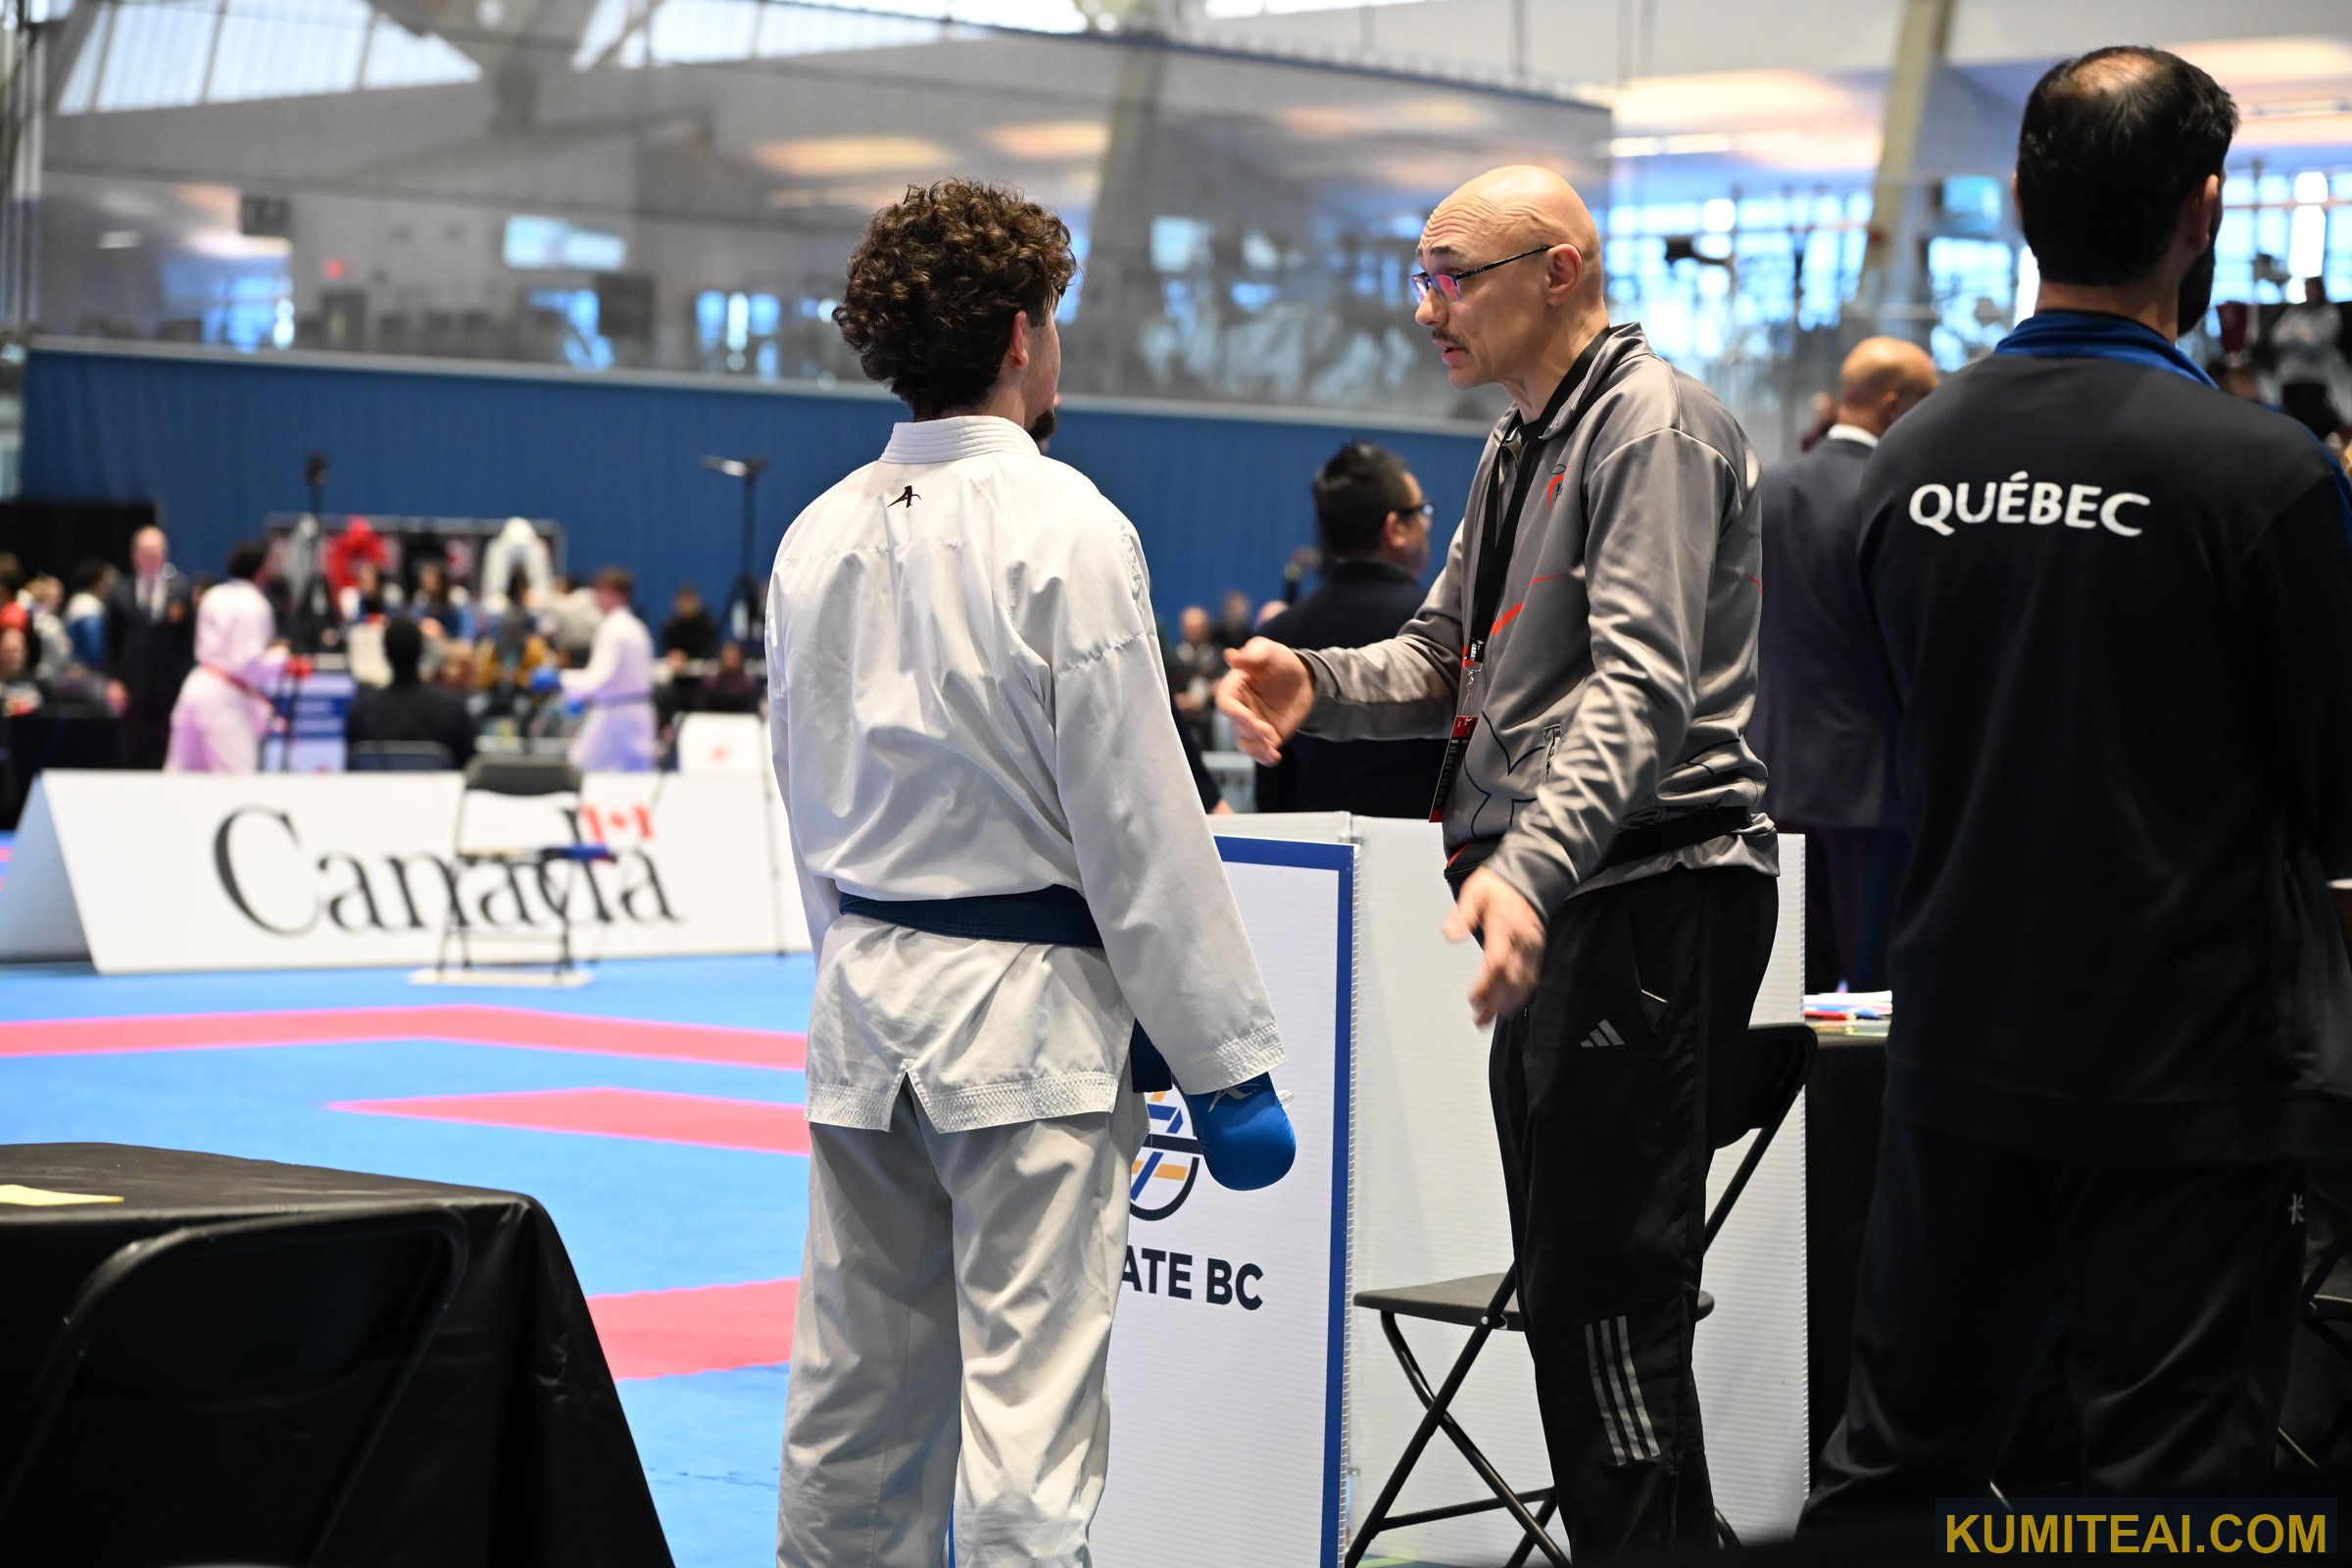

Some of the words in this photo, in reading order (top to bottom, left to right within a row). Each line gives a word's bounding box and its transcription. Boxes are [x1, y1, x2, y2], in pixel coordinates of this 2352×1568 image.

[1909, 470, 2151, 537] QUÉBEC
[212, 804, 682, 938] Canada
[1206, 1257, 1264, 1311] BC
